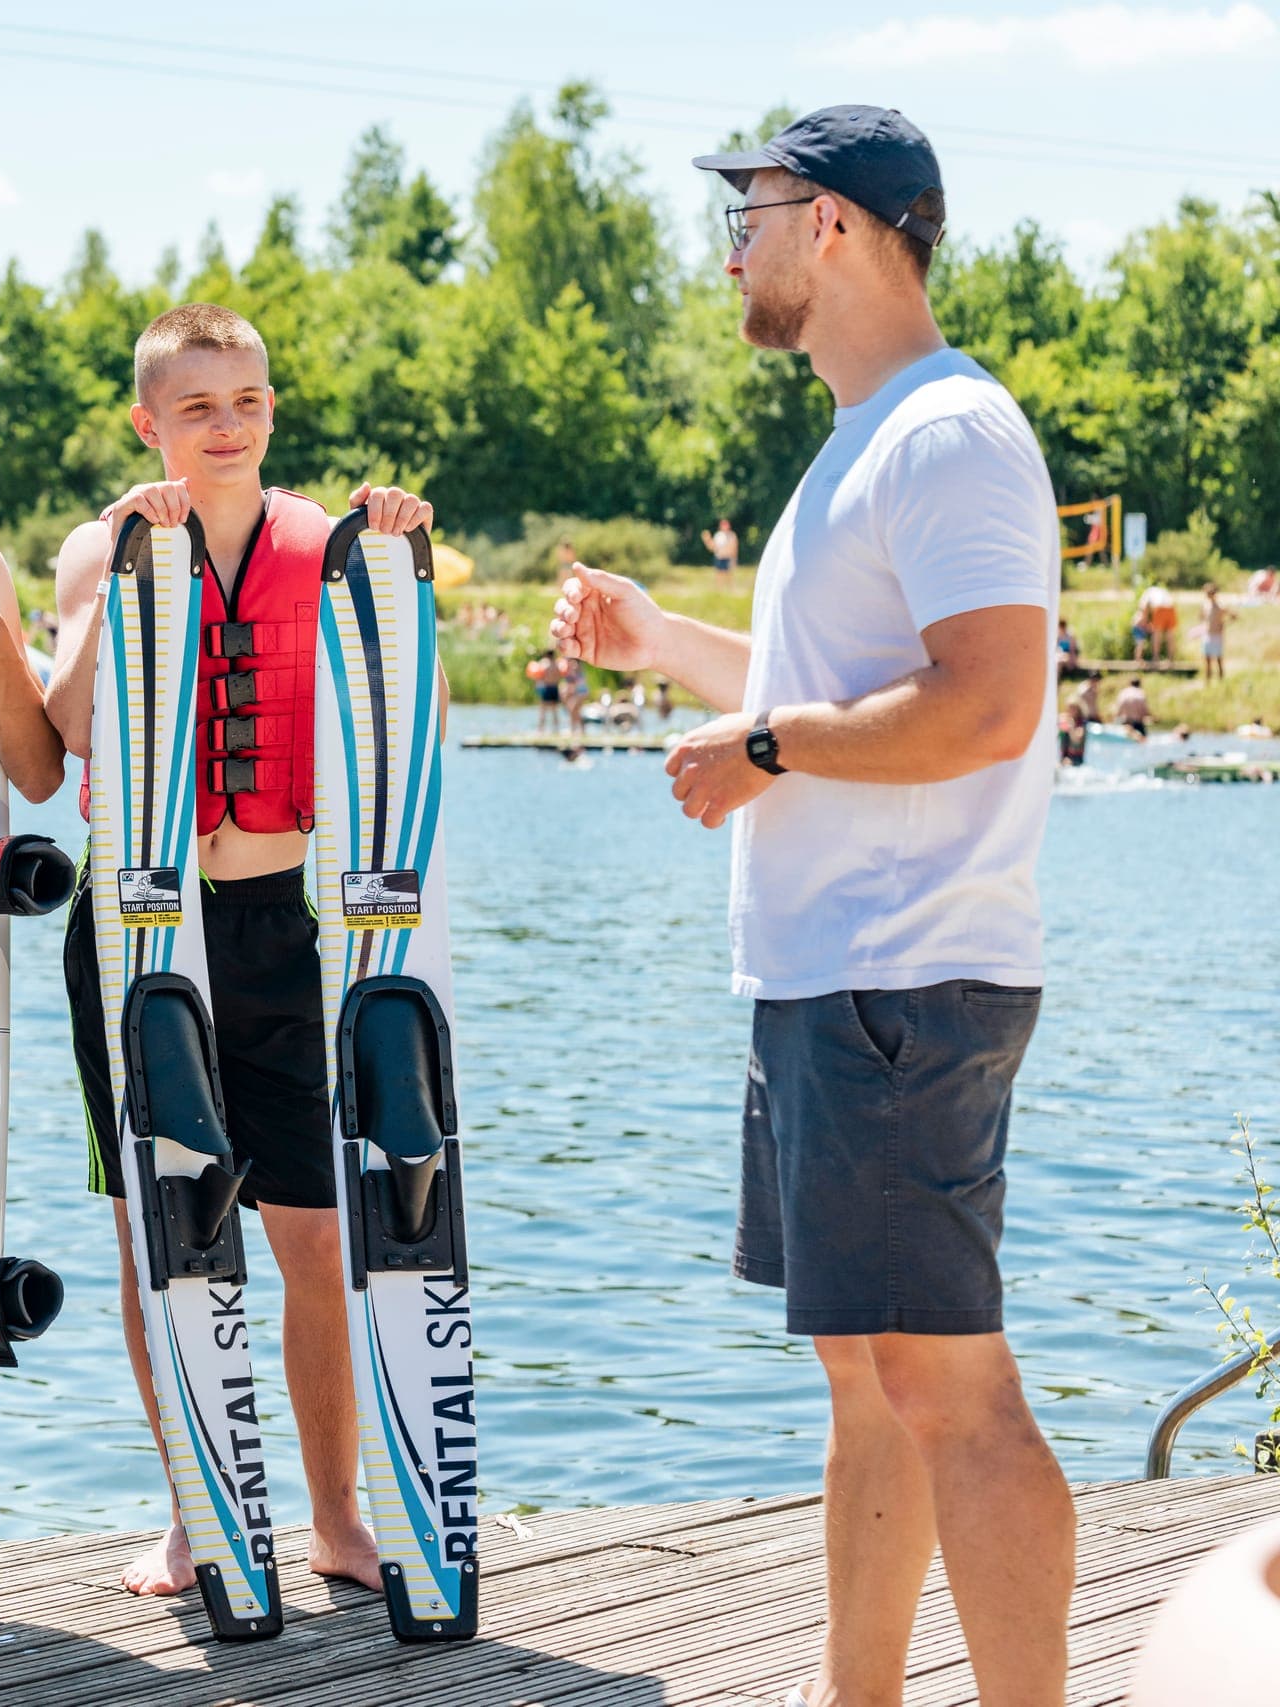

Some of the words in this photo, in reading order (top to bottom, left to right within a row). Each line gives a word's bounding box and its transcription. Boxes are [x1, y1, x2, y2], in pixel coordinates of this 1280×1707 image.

[122, 903, 145, 912] START
[146, 902, 180, 912] POSITION
[346, 905, 374, 915] START
[377, 904, 418, 914] POSITION
[430, 1360, 479, 1562] RENTAL
